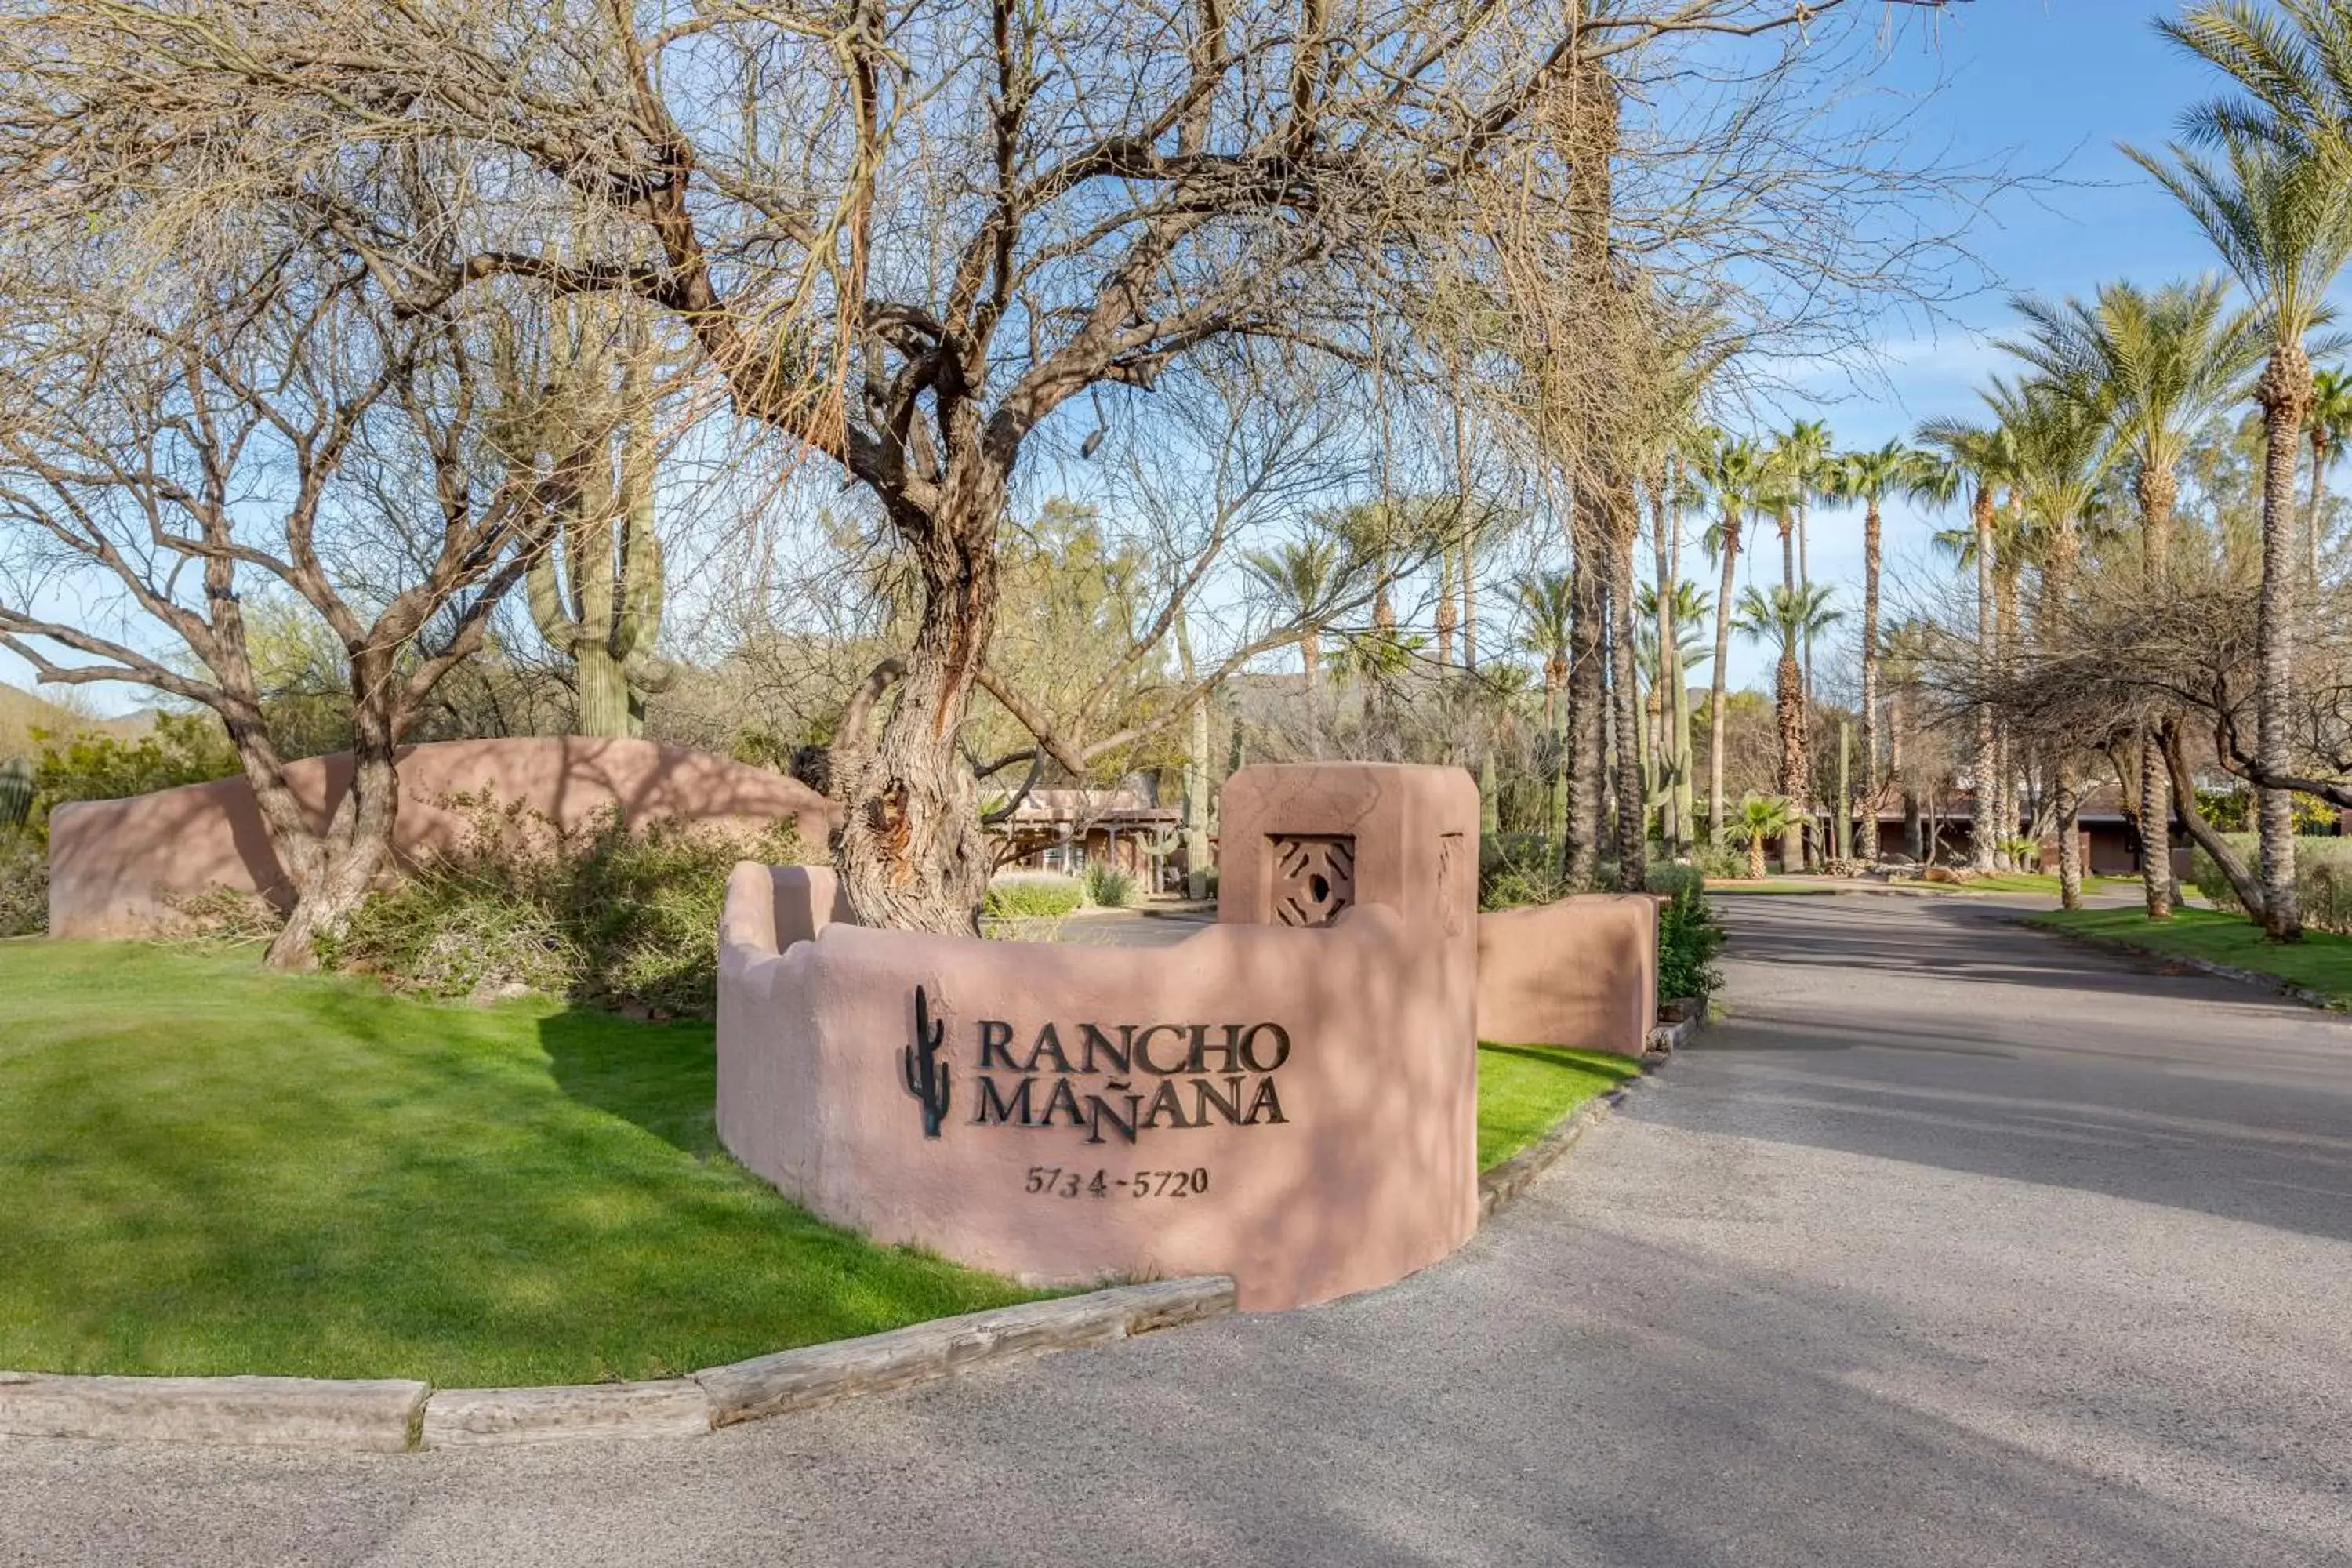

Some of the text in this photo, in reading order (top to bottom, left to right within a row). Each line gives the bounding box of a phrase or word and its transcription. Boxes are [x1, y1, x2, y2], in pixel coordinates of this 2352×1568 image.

[977, 1019, 1290, 1076] RANCHO
[975, 1075, 1289, 1145] MAÑANA
[1025, 1166, 1208, 1198] 5734-5720
